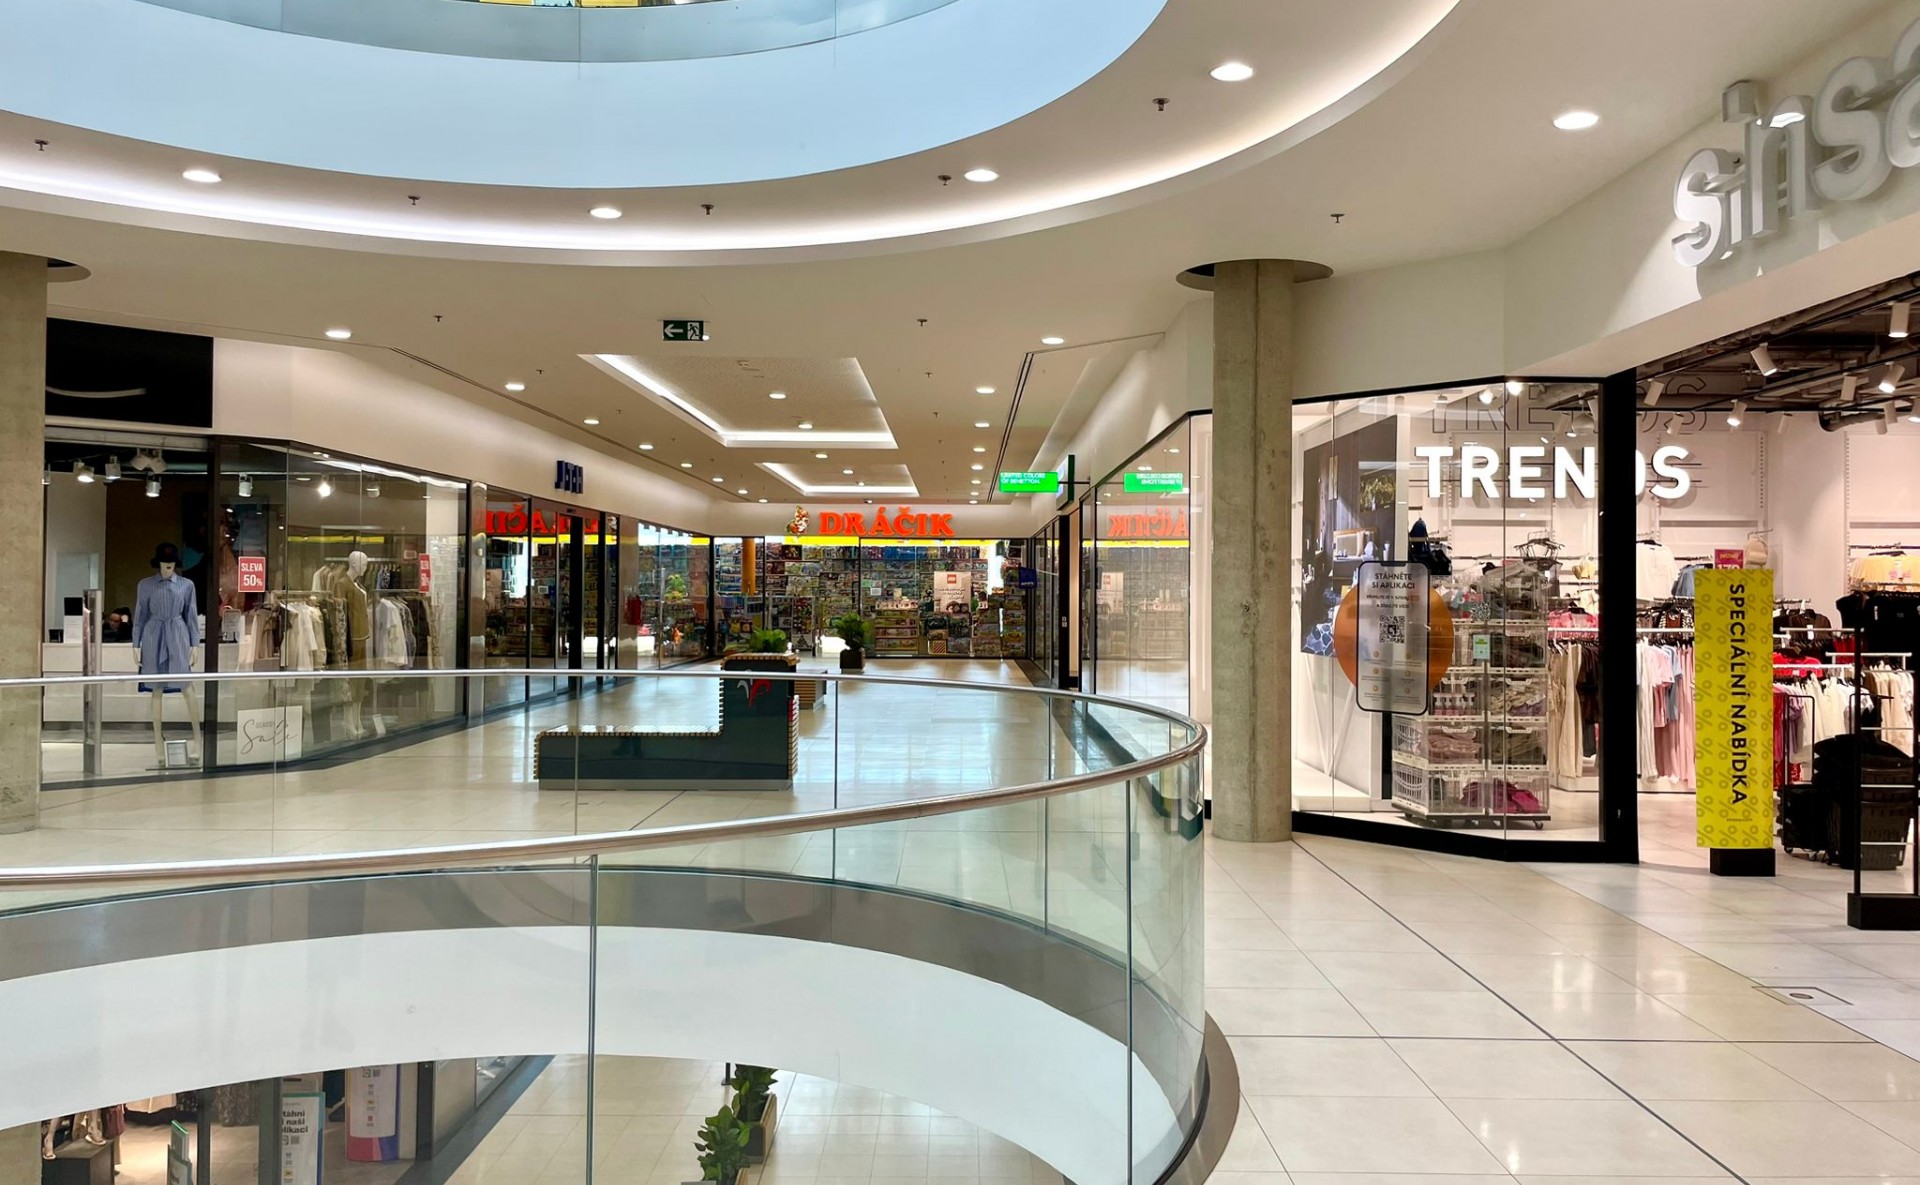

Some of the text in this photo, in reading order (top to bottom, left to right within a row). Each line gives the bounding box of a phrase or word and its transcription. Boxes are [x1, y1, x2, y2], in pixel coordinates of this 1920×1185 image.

[819, 506, 955, 536] DRÁČIK
[241, 562, 263, 572] SLEVA
[1375, 571, 1413, 580] STÁHNĚTE
[243, 574, 263, 587] 50%
[1730, 584, 1751, 698] SPECIÁLNÍ
[1731, 704, 1751, 804] NABÍDKA
